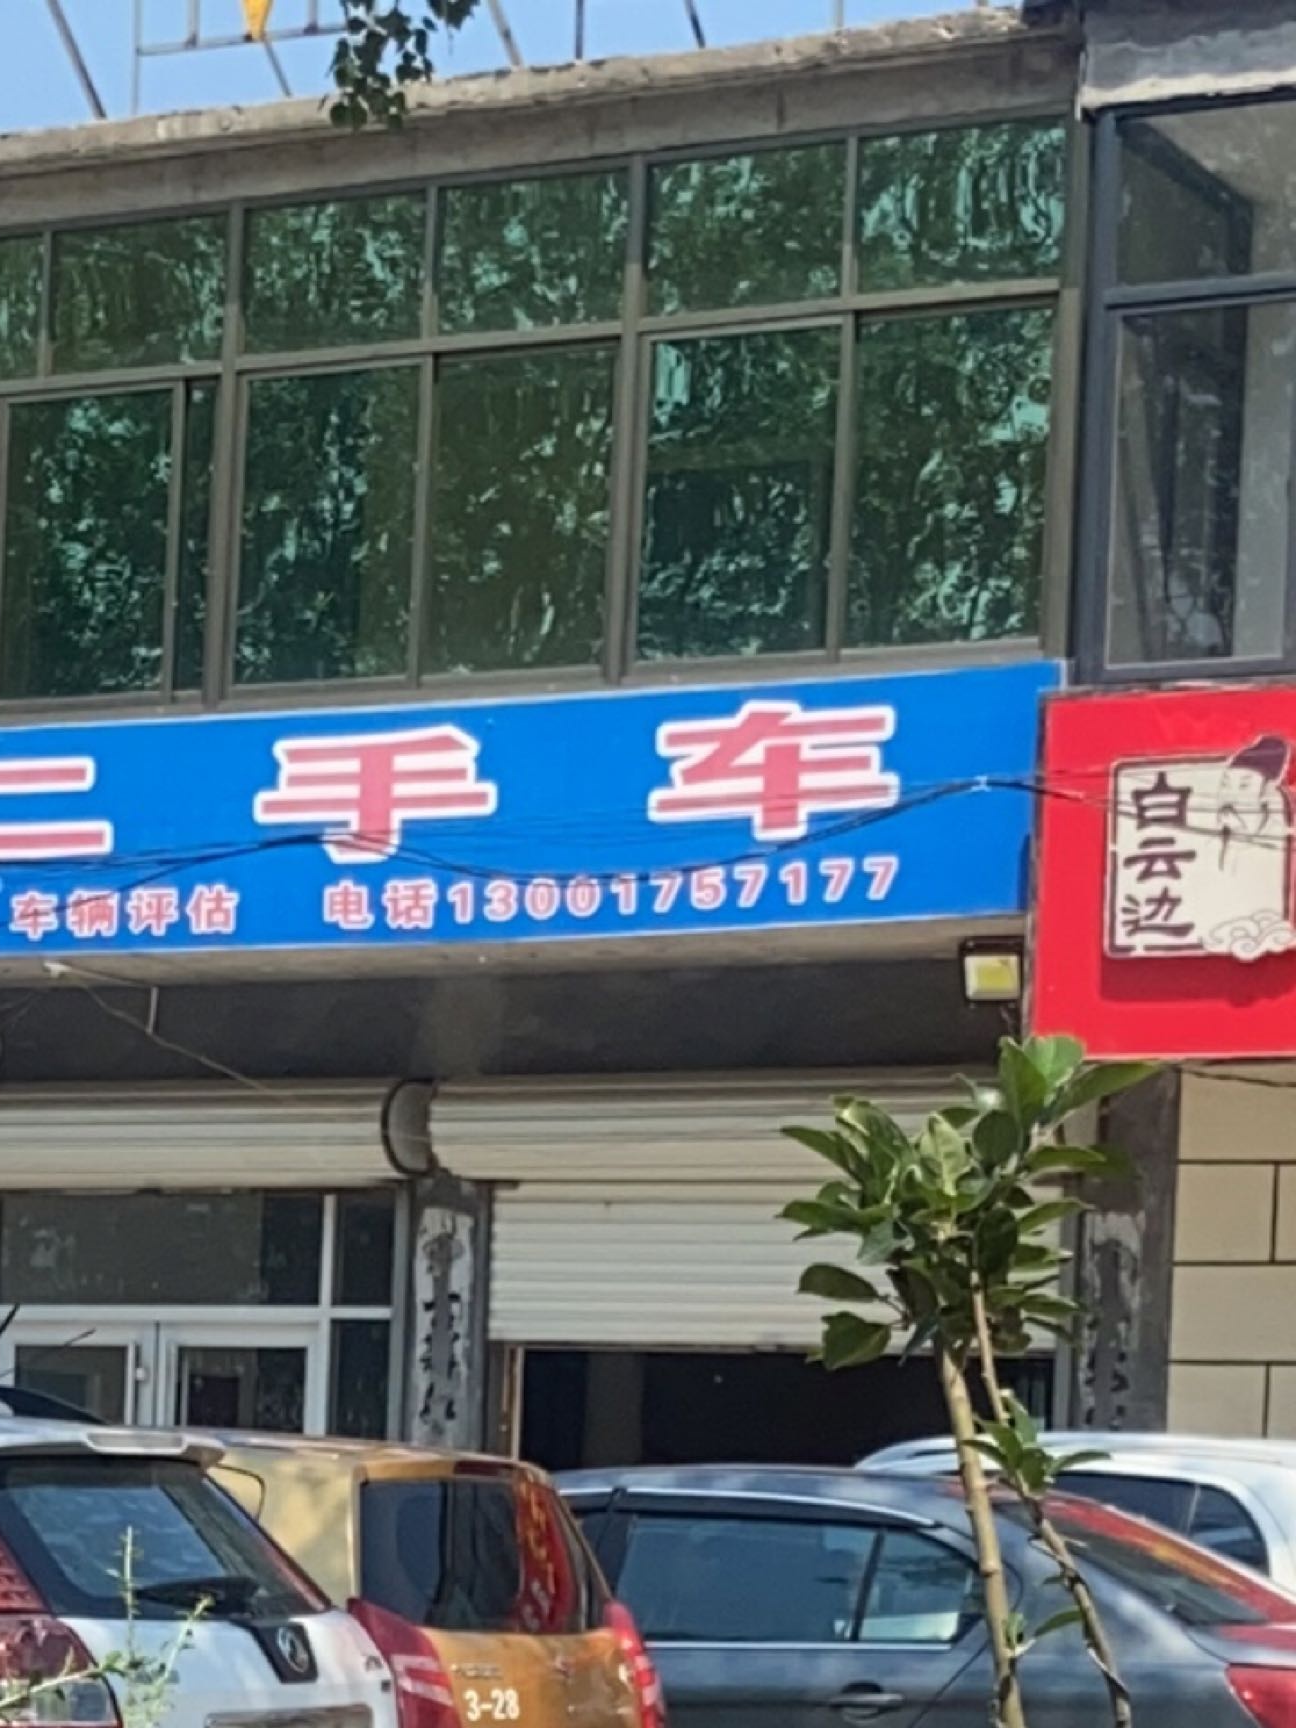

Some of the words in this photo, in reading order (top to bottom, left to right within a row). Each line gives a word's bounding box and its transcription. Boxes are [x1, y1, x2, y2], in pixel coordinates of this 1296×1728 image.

[1121, 771, 1195, 937] 白云边
[10, 884, 239, 940] 车辆评估
[322, 856, 900, 930] 电话13001757177
[463, 1688, 520, 1721] 3-28
